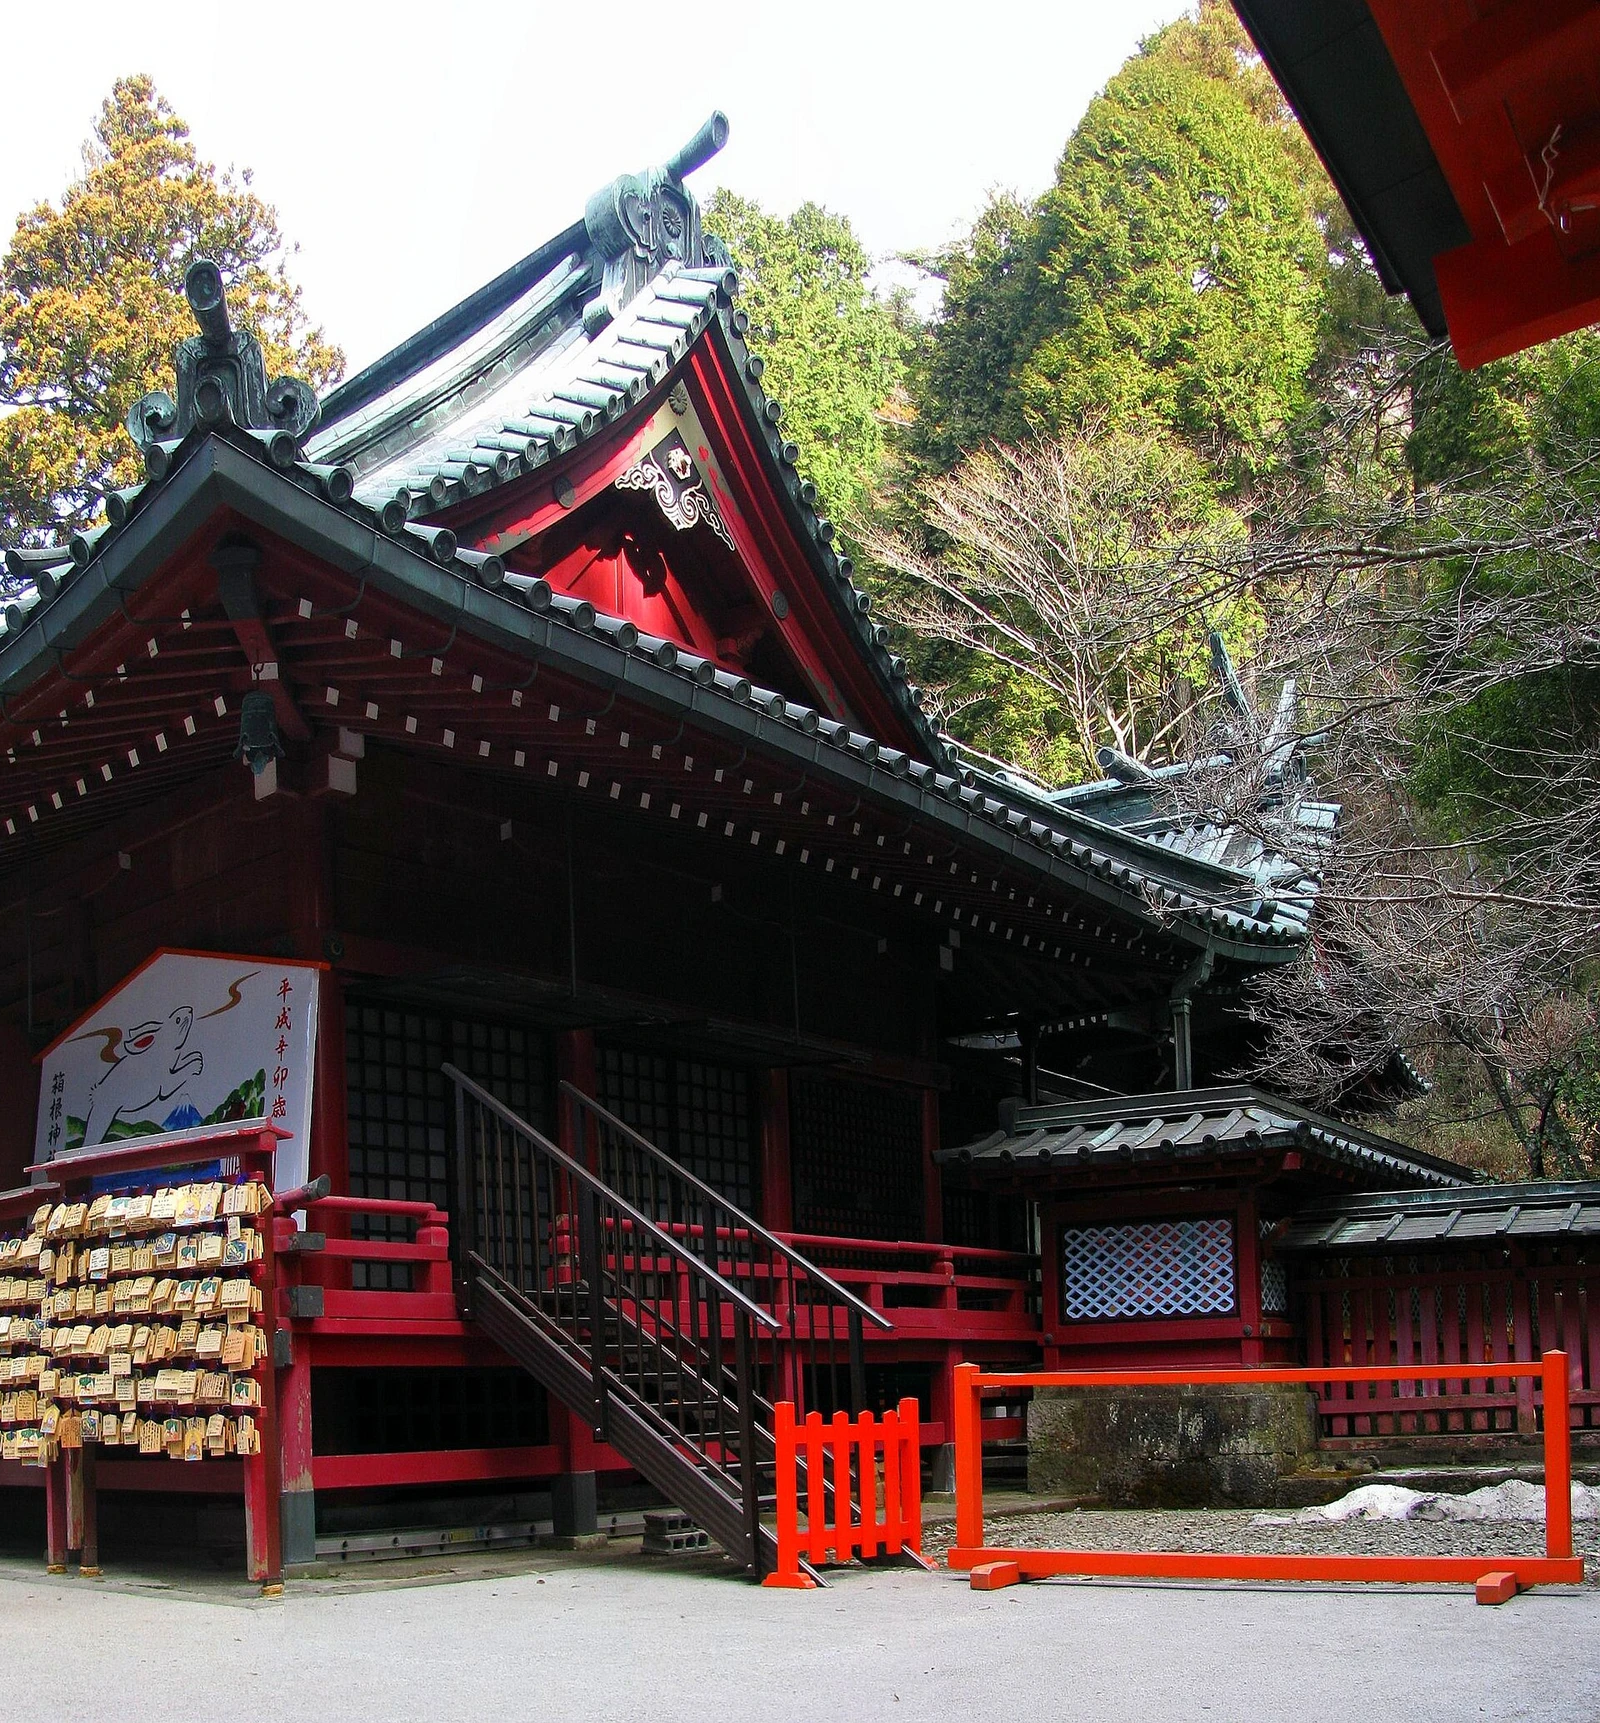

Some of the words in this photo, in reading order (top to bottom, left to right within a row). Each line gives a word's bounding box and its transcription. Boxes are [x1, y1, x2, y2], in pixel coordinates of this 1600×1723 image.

[271, 977, 293, 1118] 平成辛卯歳
